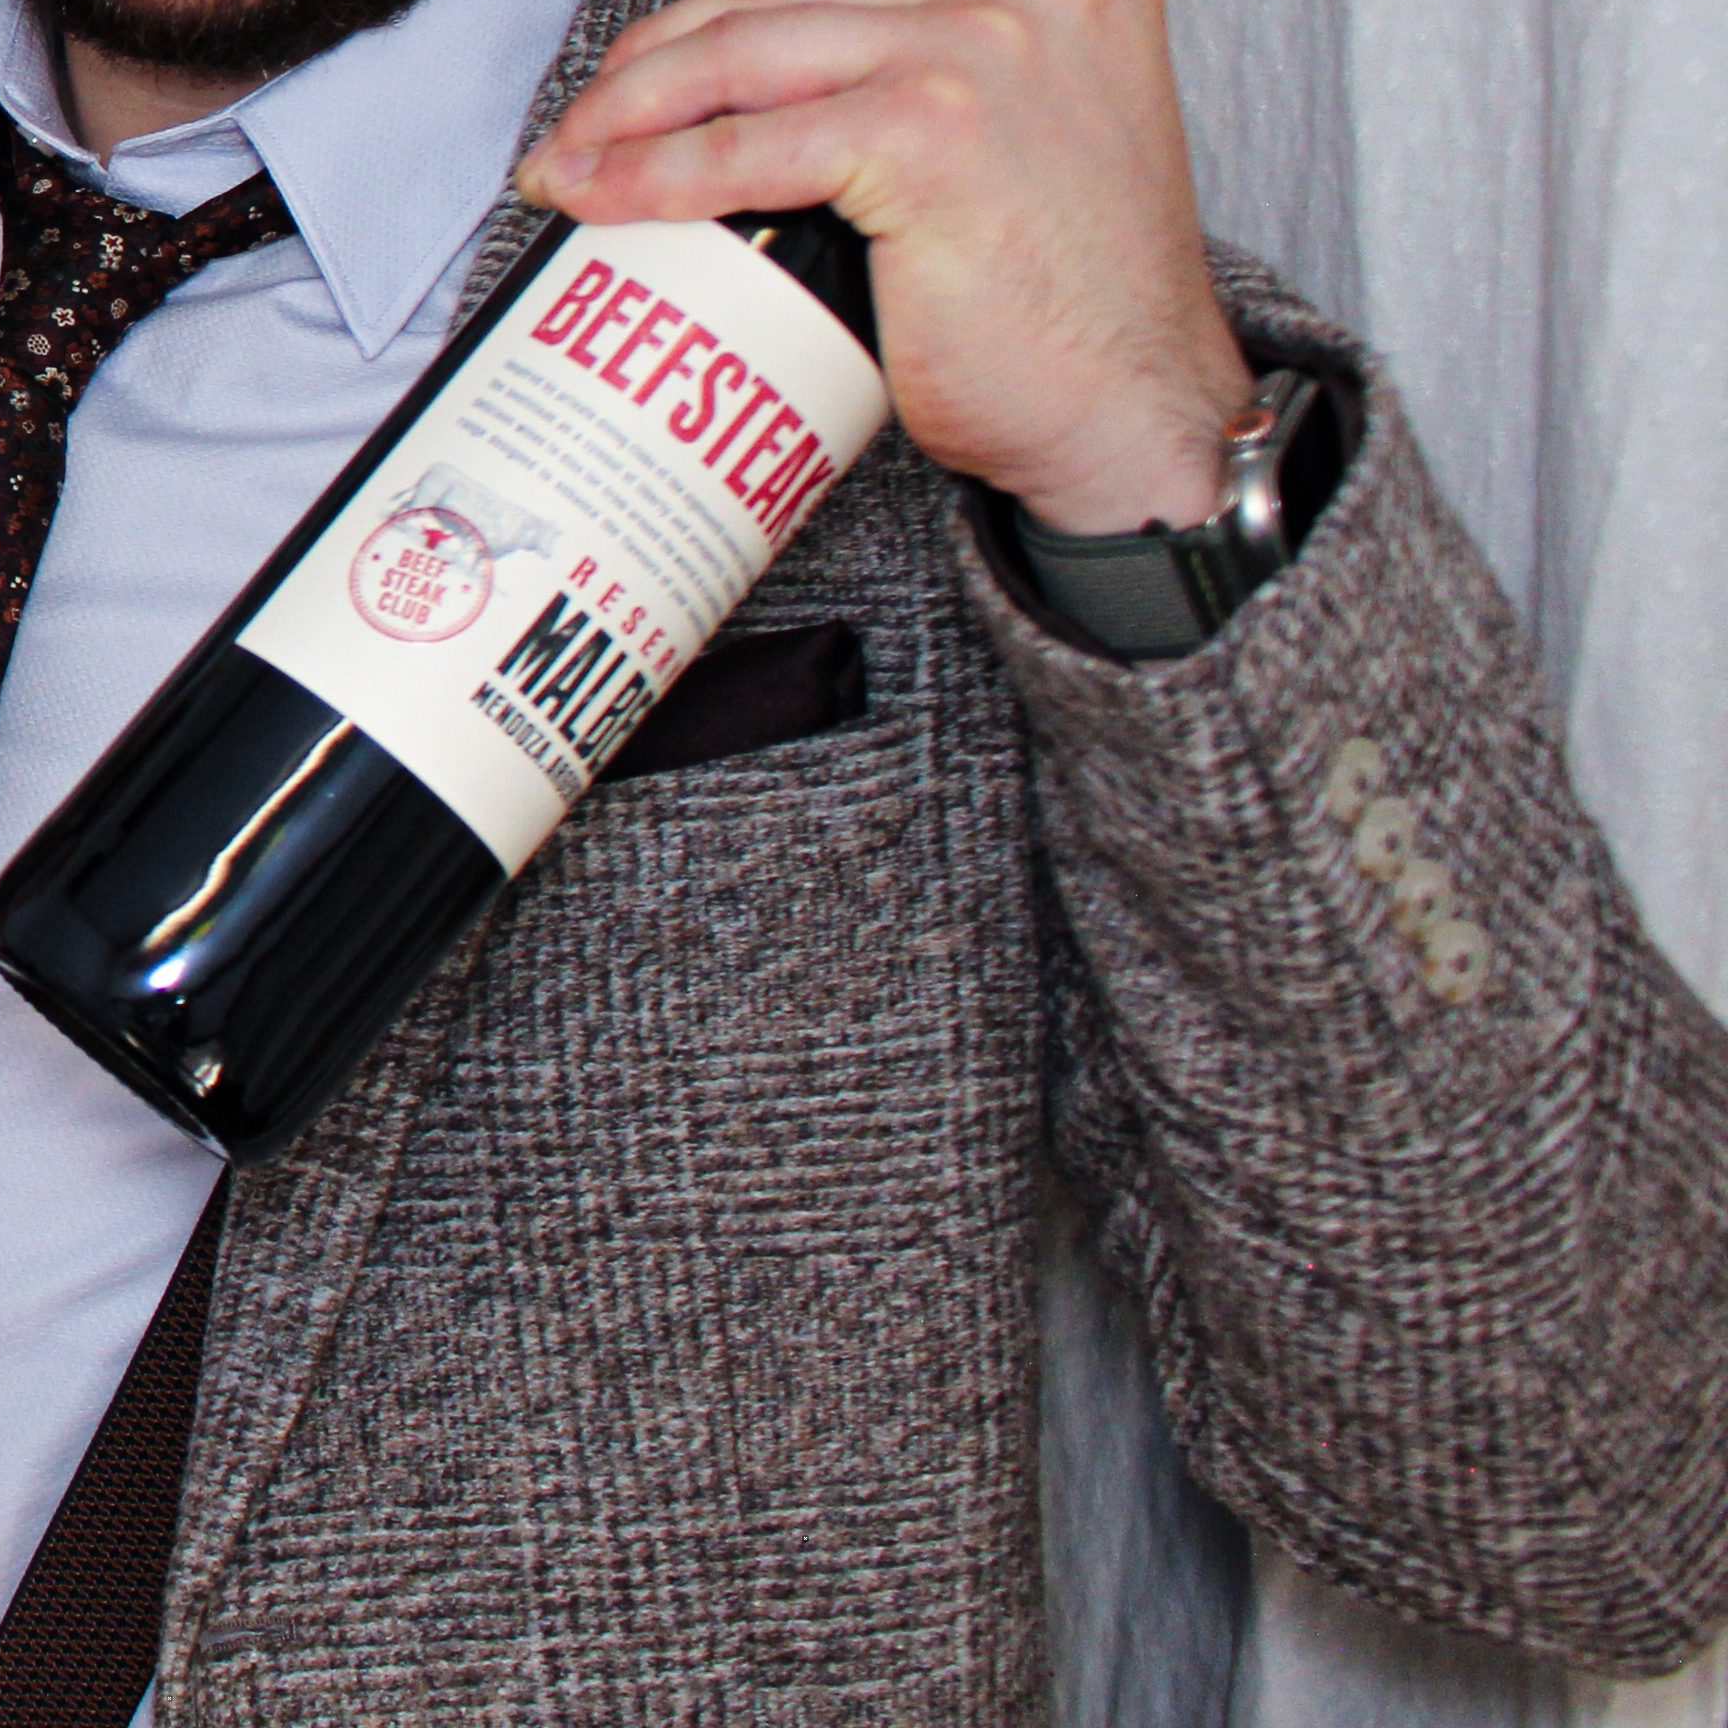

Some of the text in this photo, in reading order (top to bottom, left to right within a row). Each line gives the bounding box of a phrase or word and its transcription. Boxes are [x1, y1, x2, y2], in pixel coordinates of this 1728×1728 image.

[530, 259, 836, 545] BEEFSTEAK
[398, 549, 452, 578] BEEF
[380, 568, 448, 606] STEAK
[378, 591, 431, 624] CLUB
